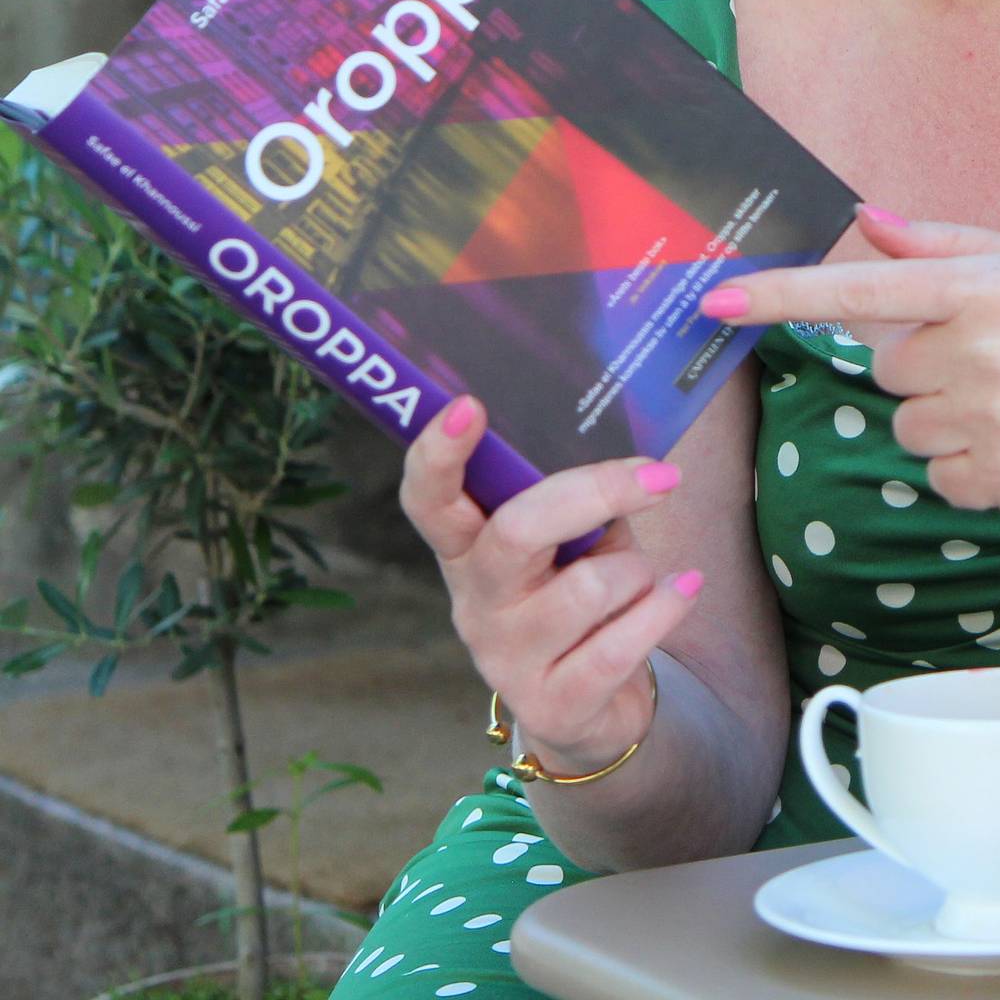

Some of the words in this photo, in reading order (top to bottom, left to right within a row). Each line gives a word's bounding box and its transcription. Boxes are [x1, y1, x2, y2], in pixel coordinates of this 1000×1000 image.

[84, 132, 124, 169] Safae
[117, 160, 137, 180] el
[130, 171, 203, 235] Khannoussi
[626, 254, 651, 282] beste
[209, 238, 422, 428] OROPPA
